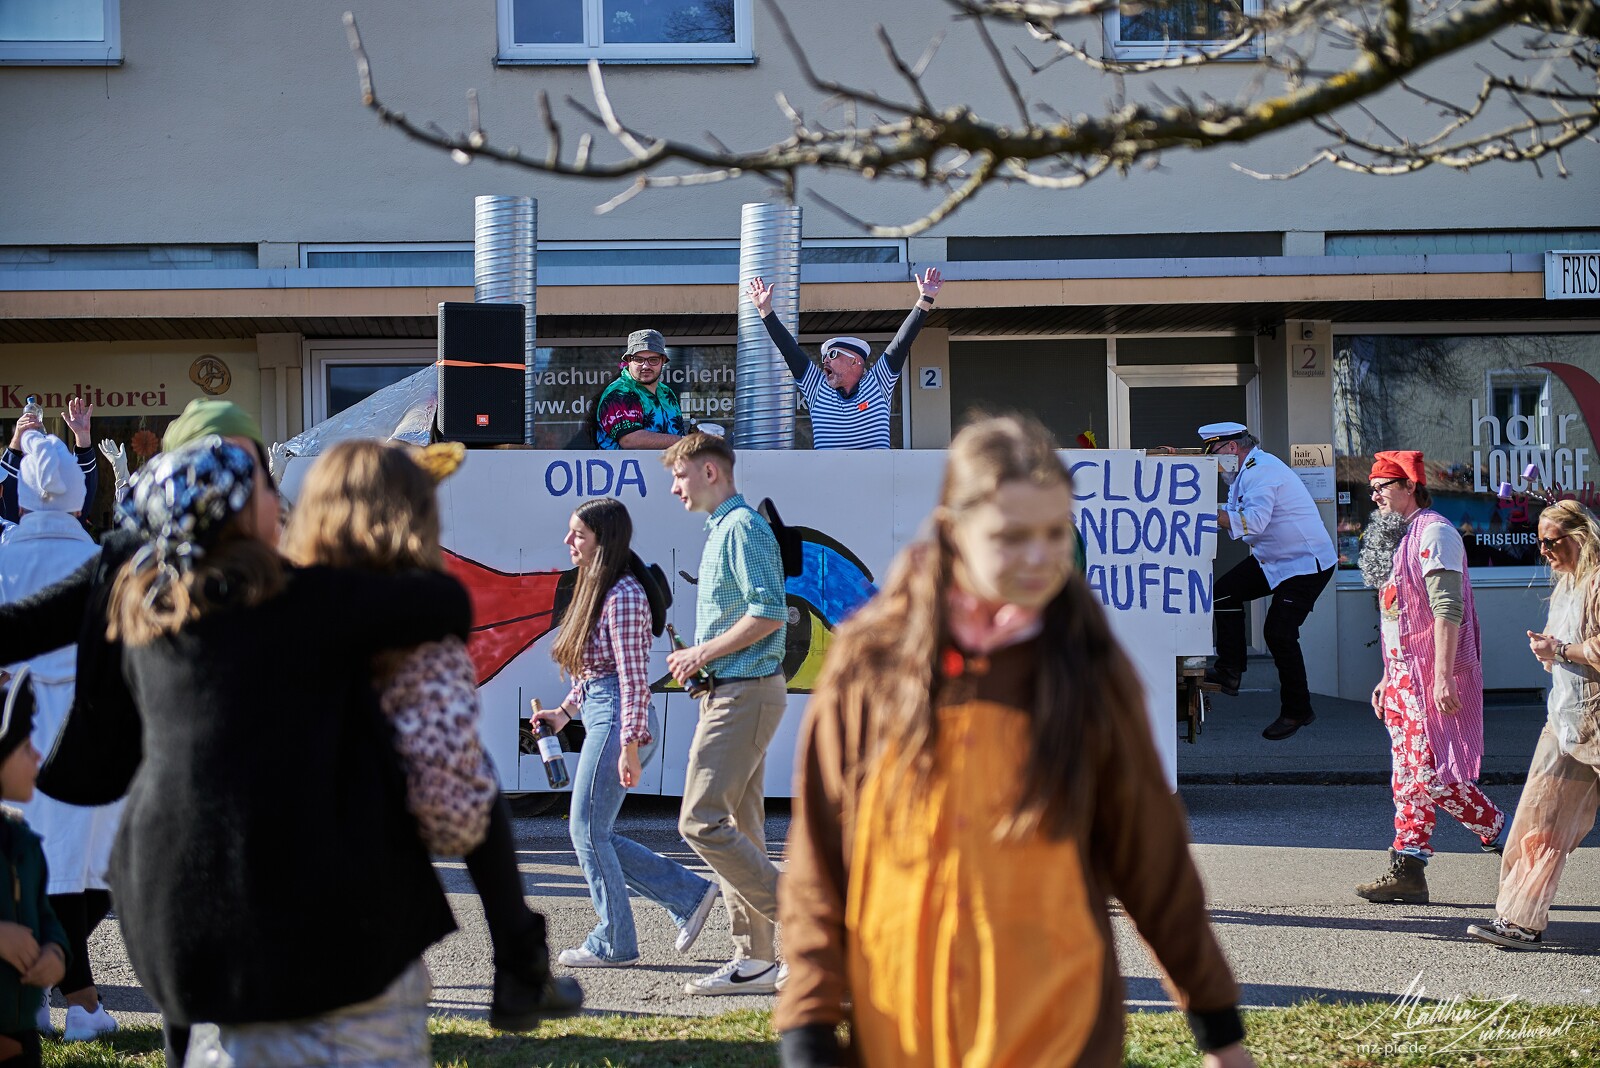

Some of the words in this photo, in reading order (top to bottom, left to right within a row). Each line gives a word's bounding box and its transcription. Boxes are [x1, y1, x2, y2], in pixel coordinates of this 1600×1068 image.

[1562, 255, 1600, 294] FRIS
[1302, 348, 1316, 369] 2
[925, 369, 937, 387] 2
[0, 383, 168, 409] Konditorei
[1471, 398, 1577, 447] hair
[1294, 450, 1311, 458] hair
[1294, 458, 1316, 466] LOUNGE
[1473, 447, 1590, 493] LOUNGE
[545, 459, 647, 497] OIDA
[1069, 459, 1201, 505] CLUB
[1070, 507, 1218, 556] NDORF
[1476, 533, 1537, 546] FRISEURS
